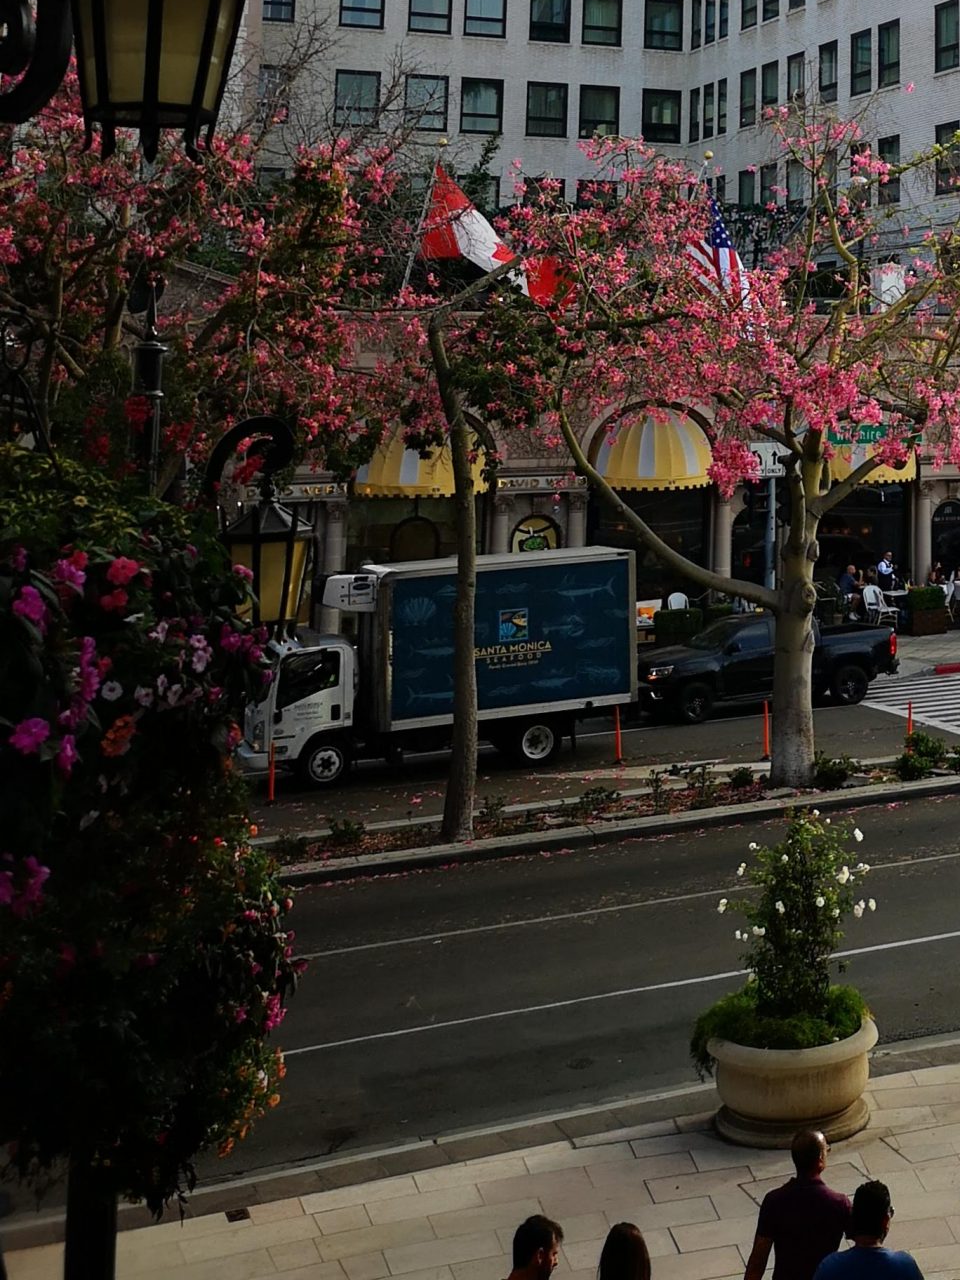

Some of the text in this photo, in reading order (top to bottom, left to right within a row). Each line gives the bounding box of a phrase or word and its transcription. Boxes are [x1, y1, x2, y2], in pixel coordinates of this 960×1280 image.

[836, 427, 882, 441] Wlhire
[497, 478, 540, 489] DAVID
[473, 640, 552, 657] SANTA MONICA
[486, 652, 542, 664] SEAFOOD
